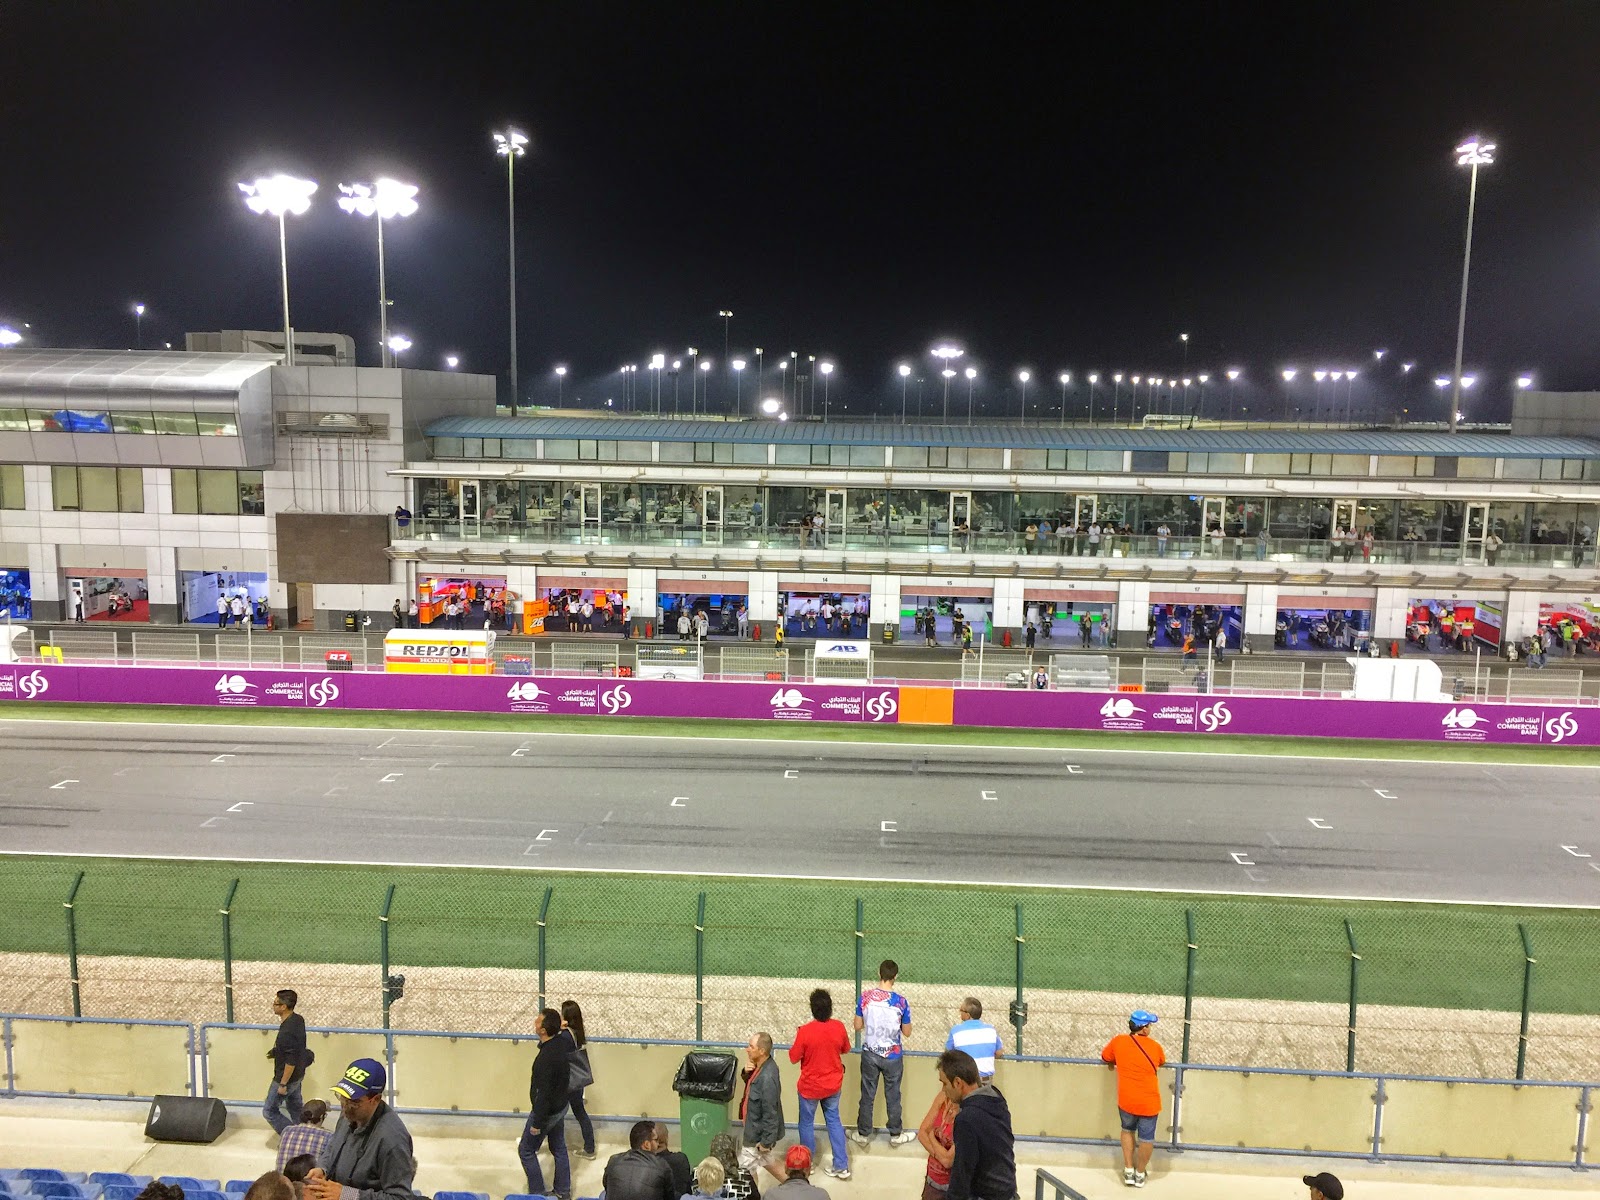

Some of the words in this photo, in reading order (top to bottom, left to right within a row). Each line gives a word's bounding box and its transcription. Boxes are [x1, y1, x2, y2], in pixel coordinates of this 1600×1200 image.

[530, 617, 544, 628] 26
[403, 645, 469, 657] REPSOL
[214, 673, 247, 694] 40
[506, 681, 539, 701] 40
[770, 688, 803, 708] 40
[1100, 697, 1134, 718] 40
[1442, 707, 1477, 728] 40
[345, 1066, 370, 1083] 46
